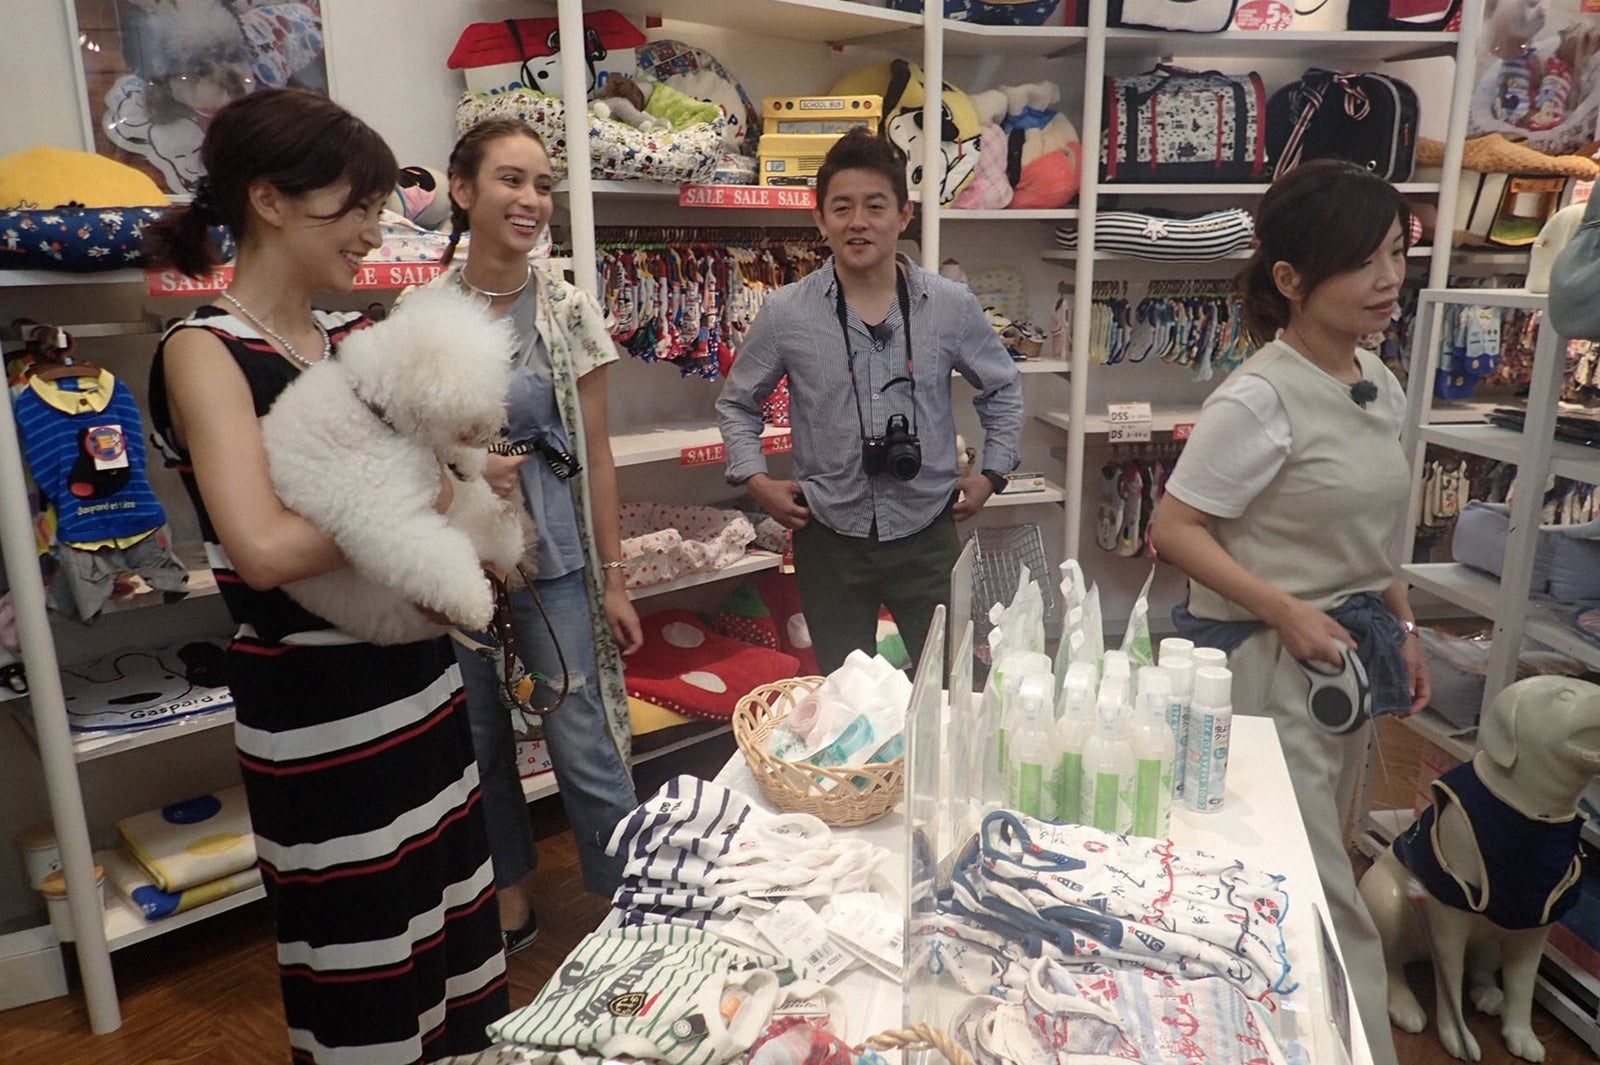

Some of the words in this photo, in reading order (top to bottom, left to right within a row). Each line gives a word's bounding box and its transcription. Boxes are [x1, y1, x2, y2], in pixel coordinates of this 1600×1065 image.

[803, 101, 827, 109] SCHOOL
[686, 189, 725, 205] SALE
[734, 190, 769, 205] SALE
[778, 192, 811, 206] SALE
[353, 267, 377, 285] LE
[1111, 412, 1129, 421] DSS
[1111, 430, 1124, 439] DS
[687, 446, 722, 464] SALE
[773, 437, 792, 451] SA
[130, 696, 214, 719] Gaspard
[1200, 755, 1210, 784] SPRAY
[1197, 786, 1207, 809] COOL
